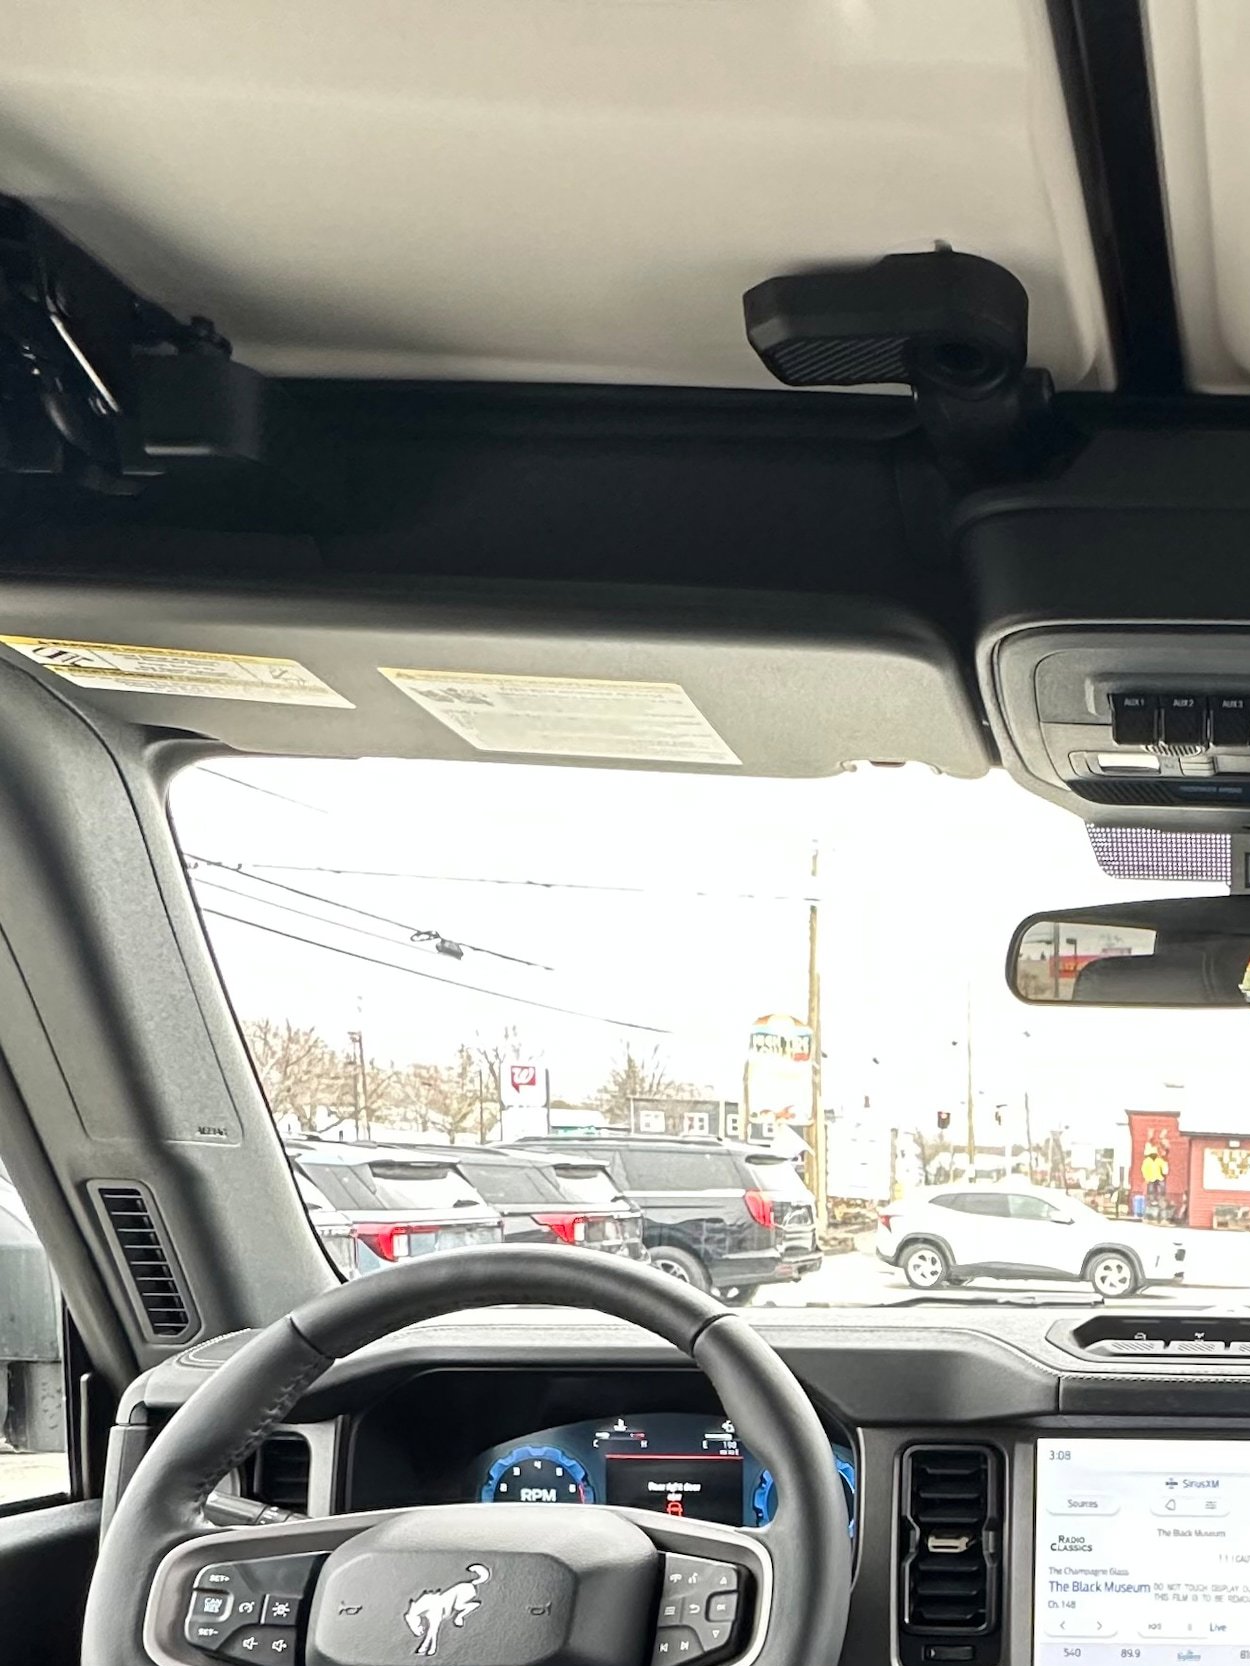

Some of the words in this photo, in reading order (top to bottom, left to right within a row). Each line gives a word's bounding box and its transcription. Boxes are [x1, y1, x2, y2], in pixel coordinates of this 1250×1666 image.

[1048, 1449, 1072, 1461] 3:08
[519, 1487, 558, 1502] RPM
[1048, 1580, 1070, 1592] The
[1072, 1580, 1102, 1593] Black
[1104, 1582, 1151, 1594] Museum
[1209, 1622, 1227, 1632] Live
[1120, 1648, 1141, 1659] 89.9
